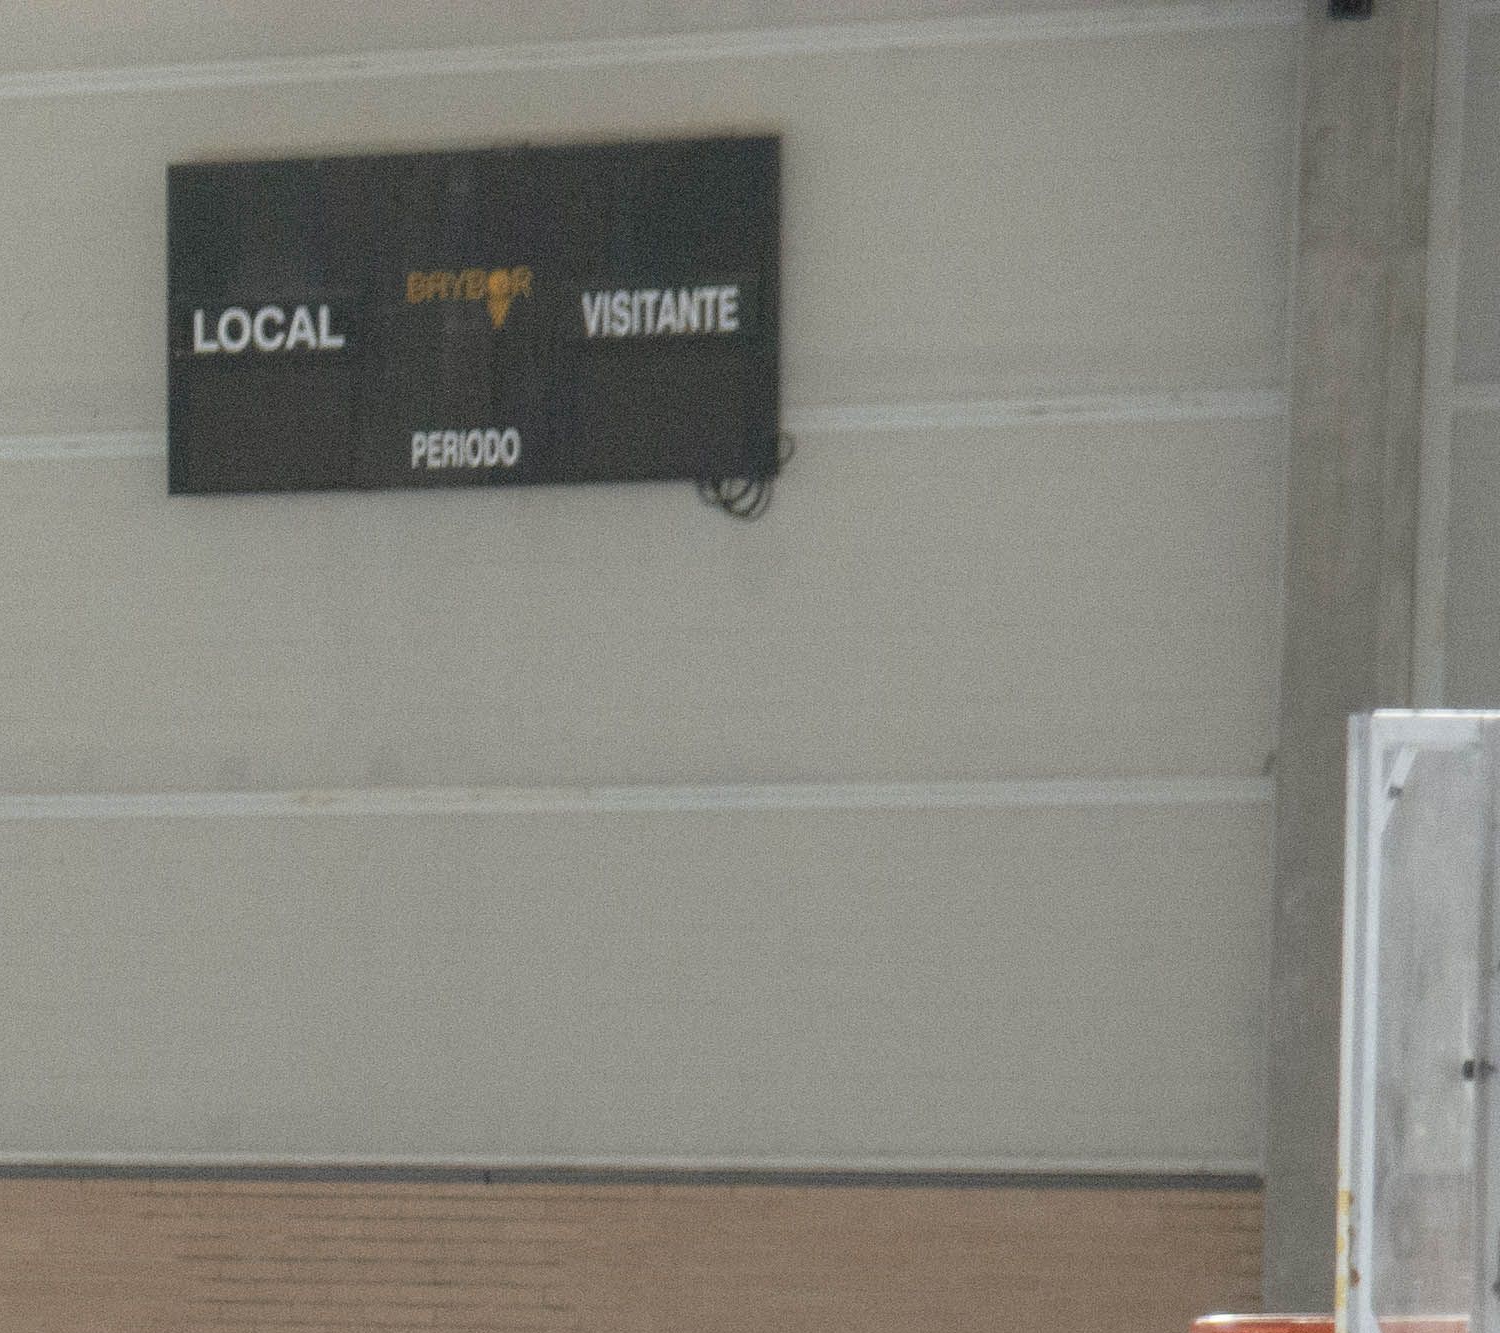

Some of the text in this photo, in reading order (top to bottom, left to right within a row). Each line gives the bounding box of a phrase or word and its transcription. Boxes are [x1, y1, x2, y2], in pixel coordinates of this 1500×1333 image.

[193, 305, 346, 354] LOCAL
[581, 285, 740, 337] VISITANTE
[410, 428, 521, 469] PERIODO
